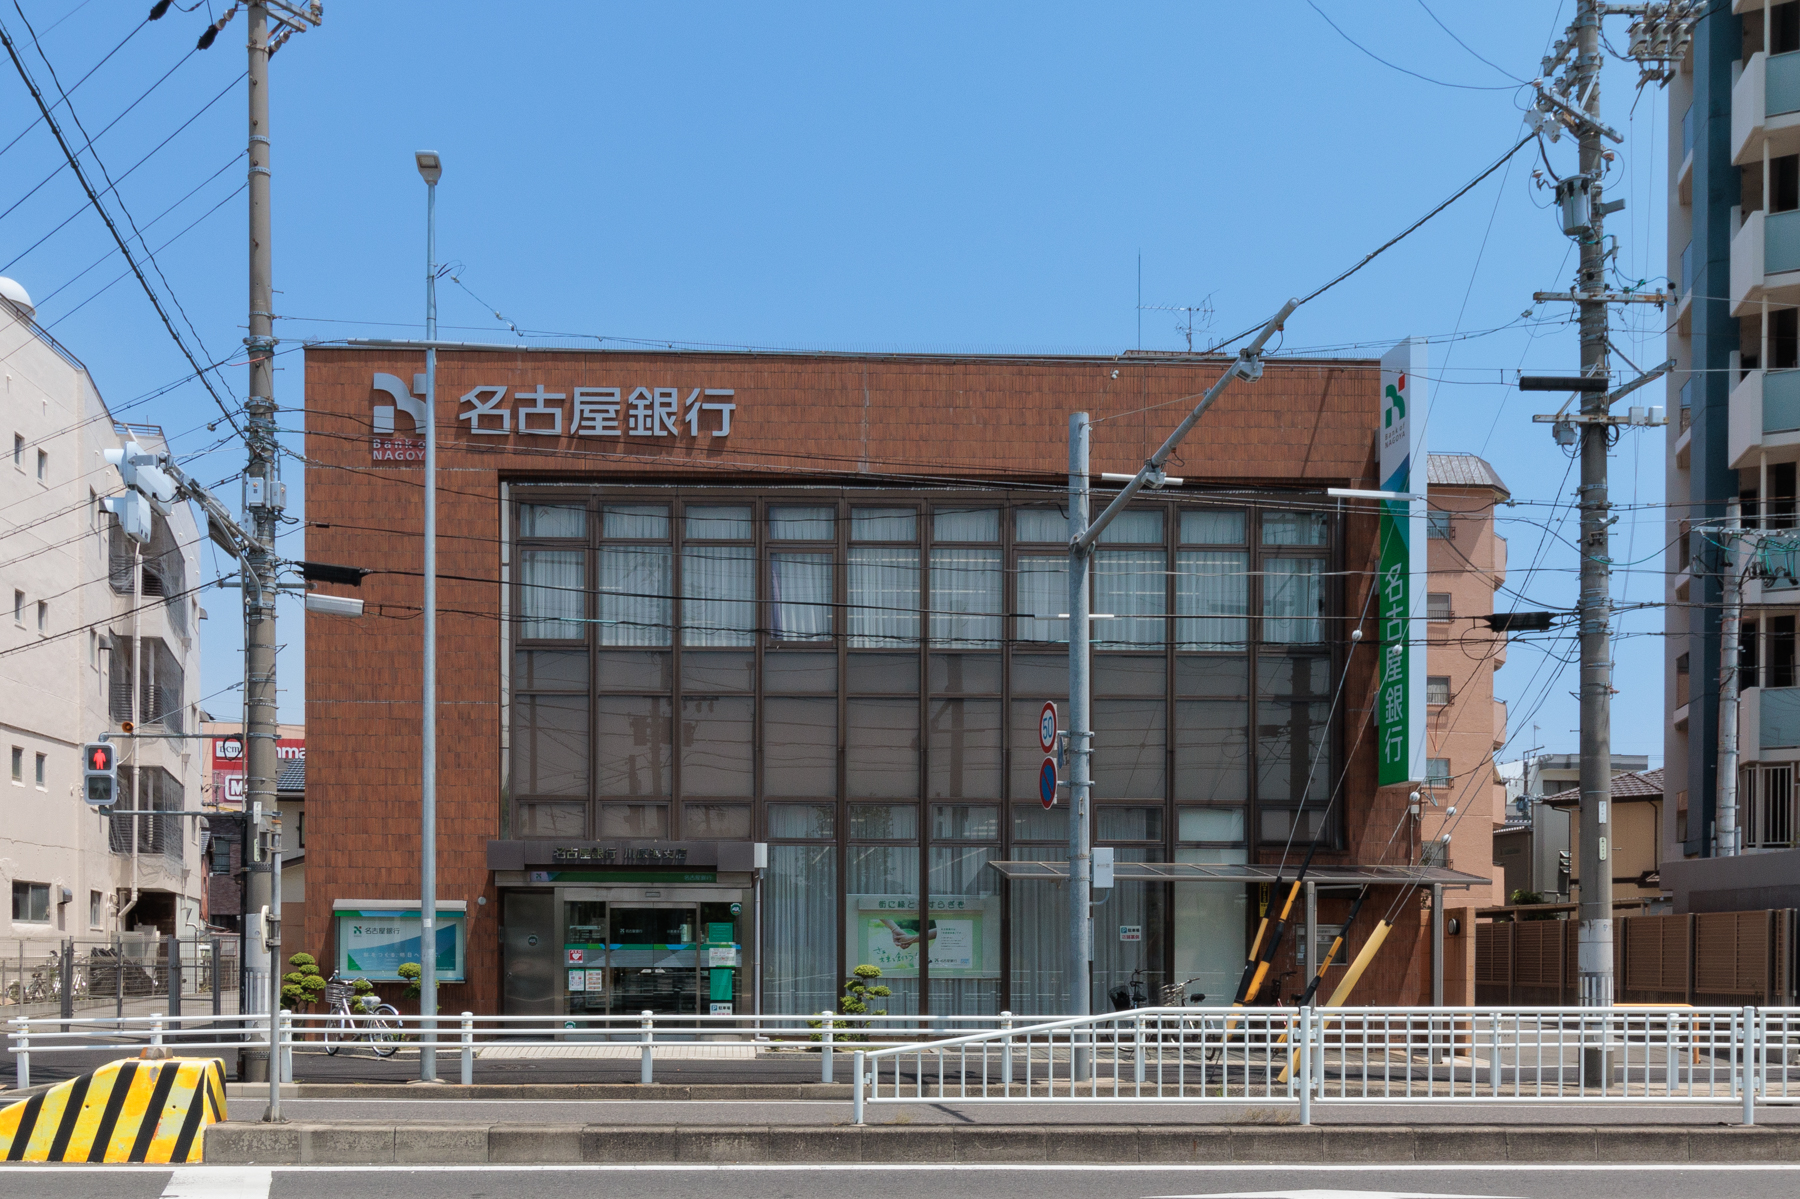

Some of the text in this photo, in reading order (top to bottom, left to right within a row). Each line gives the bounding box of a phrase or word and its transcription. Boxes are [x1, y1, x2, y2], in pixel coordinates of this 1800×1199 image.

[459, 384, 736, 437] 名古屋銀行
[373, 438, 413, 449] Bank
[373, 450, 426, 461] NAGOY
[1385, 562, 1404, 764] 名古屋銀行
[1042, 716, 1053, 739] 50
[554, 847, 617, 860] 名古屋銀行
[878, 900, 965, 909] 街に緑とすらぎを
[364, 927, 400, 935] 名古屋銀行
